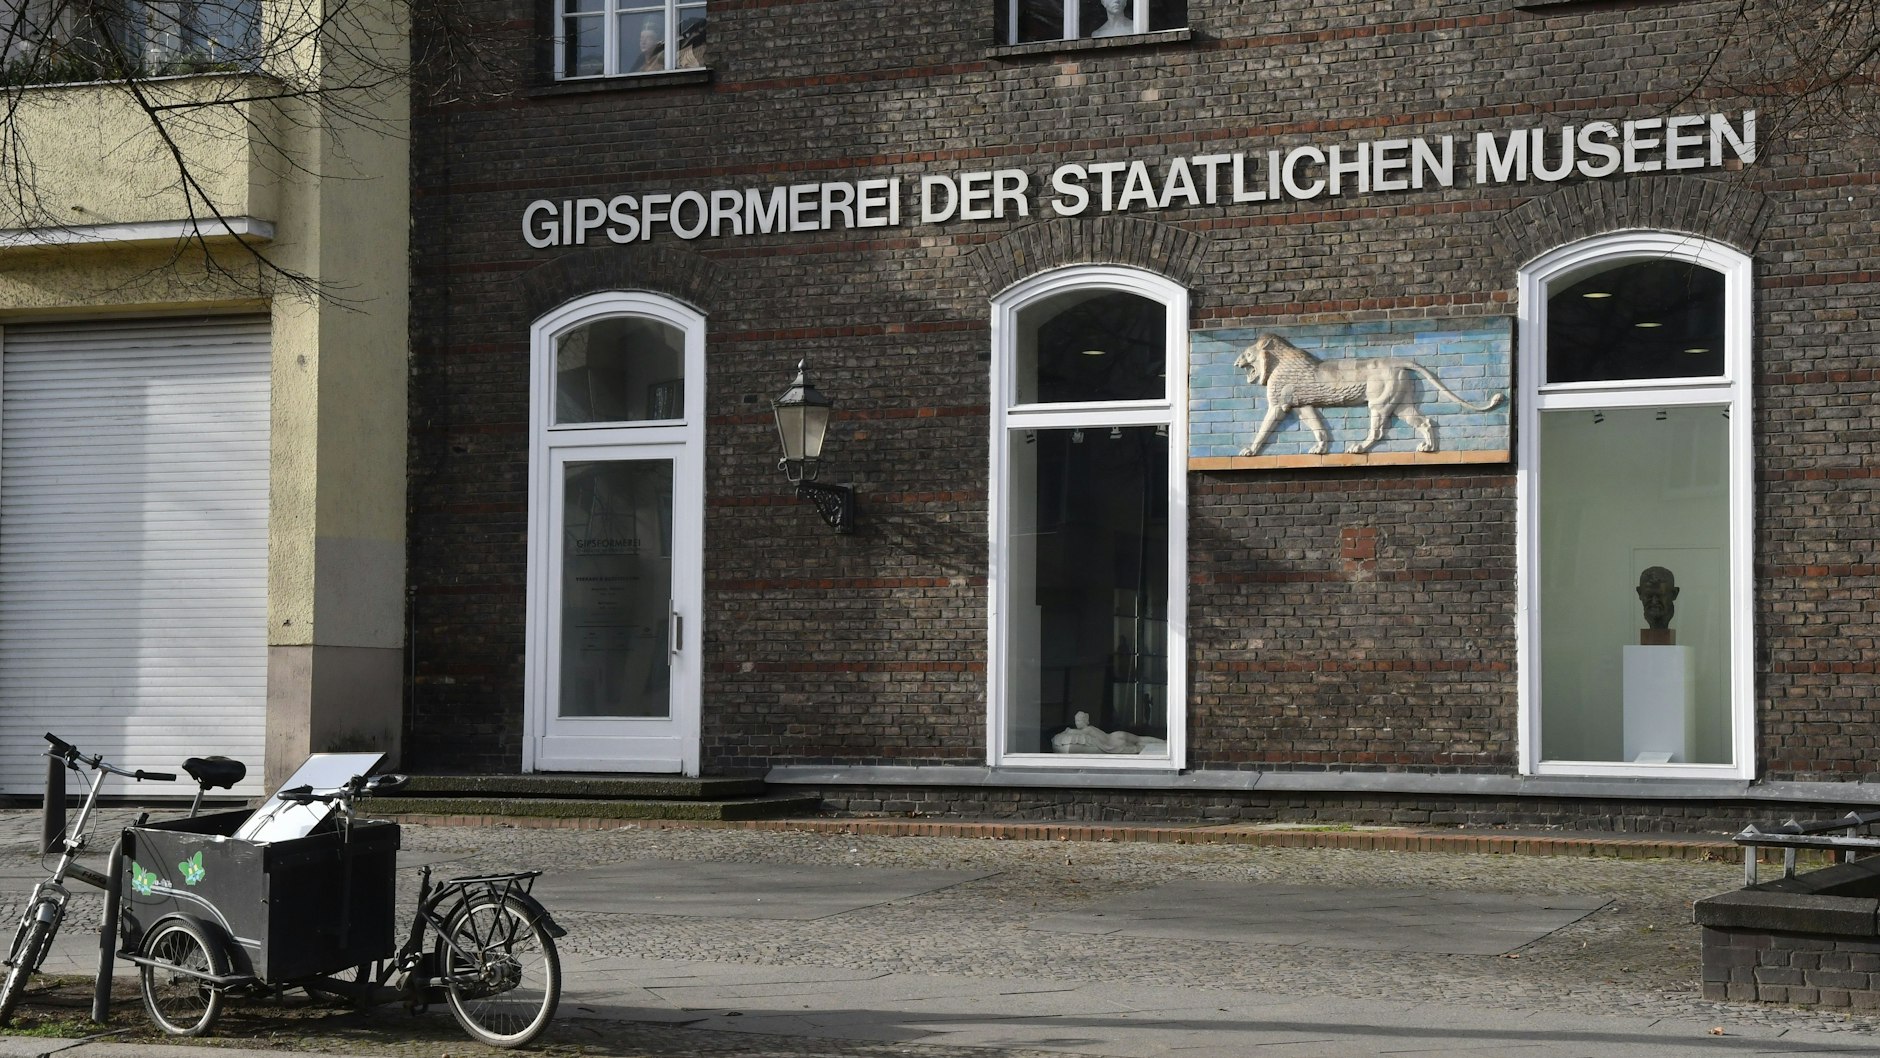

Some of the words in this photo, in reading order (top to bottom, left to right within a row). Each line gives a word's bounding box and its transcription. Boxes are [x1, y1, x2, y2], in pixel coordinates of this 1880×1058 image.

[522, 178, 900, 249] GIPSFORMEREI
[921, 168, 1029, 223] DER
[1051, 134, 1454, 216] STAATLICHEN
[1475, 109, 1756, 184] MUSEEN
[576, 538, 641, 549] GIPSFORMEREI
